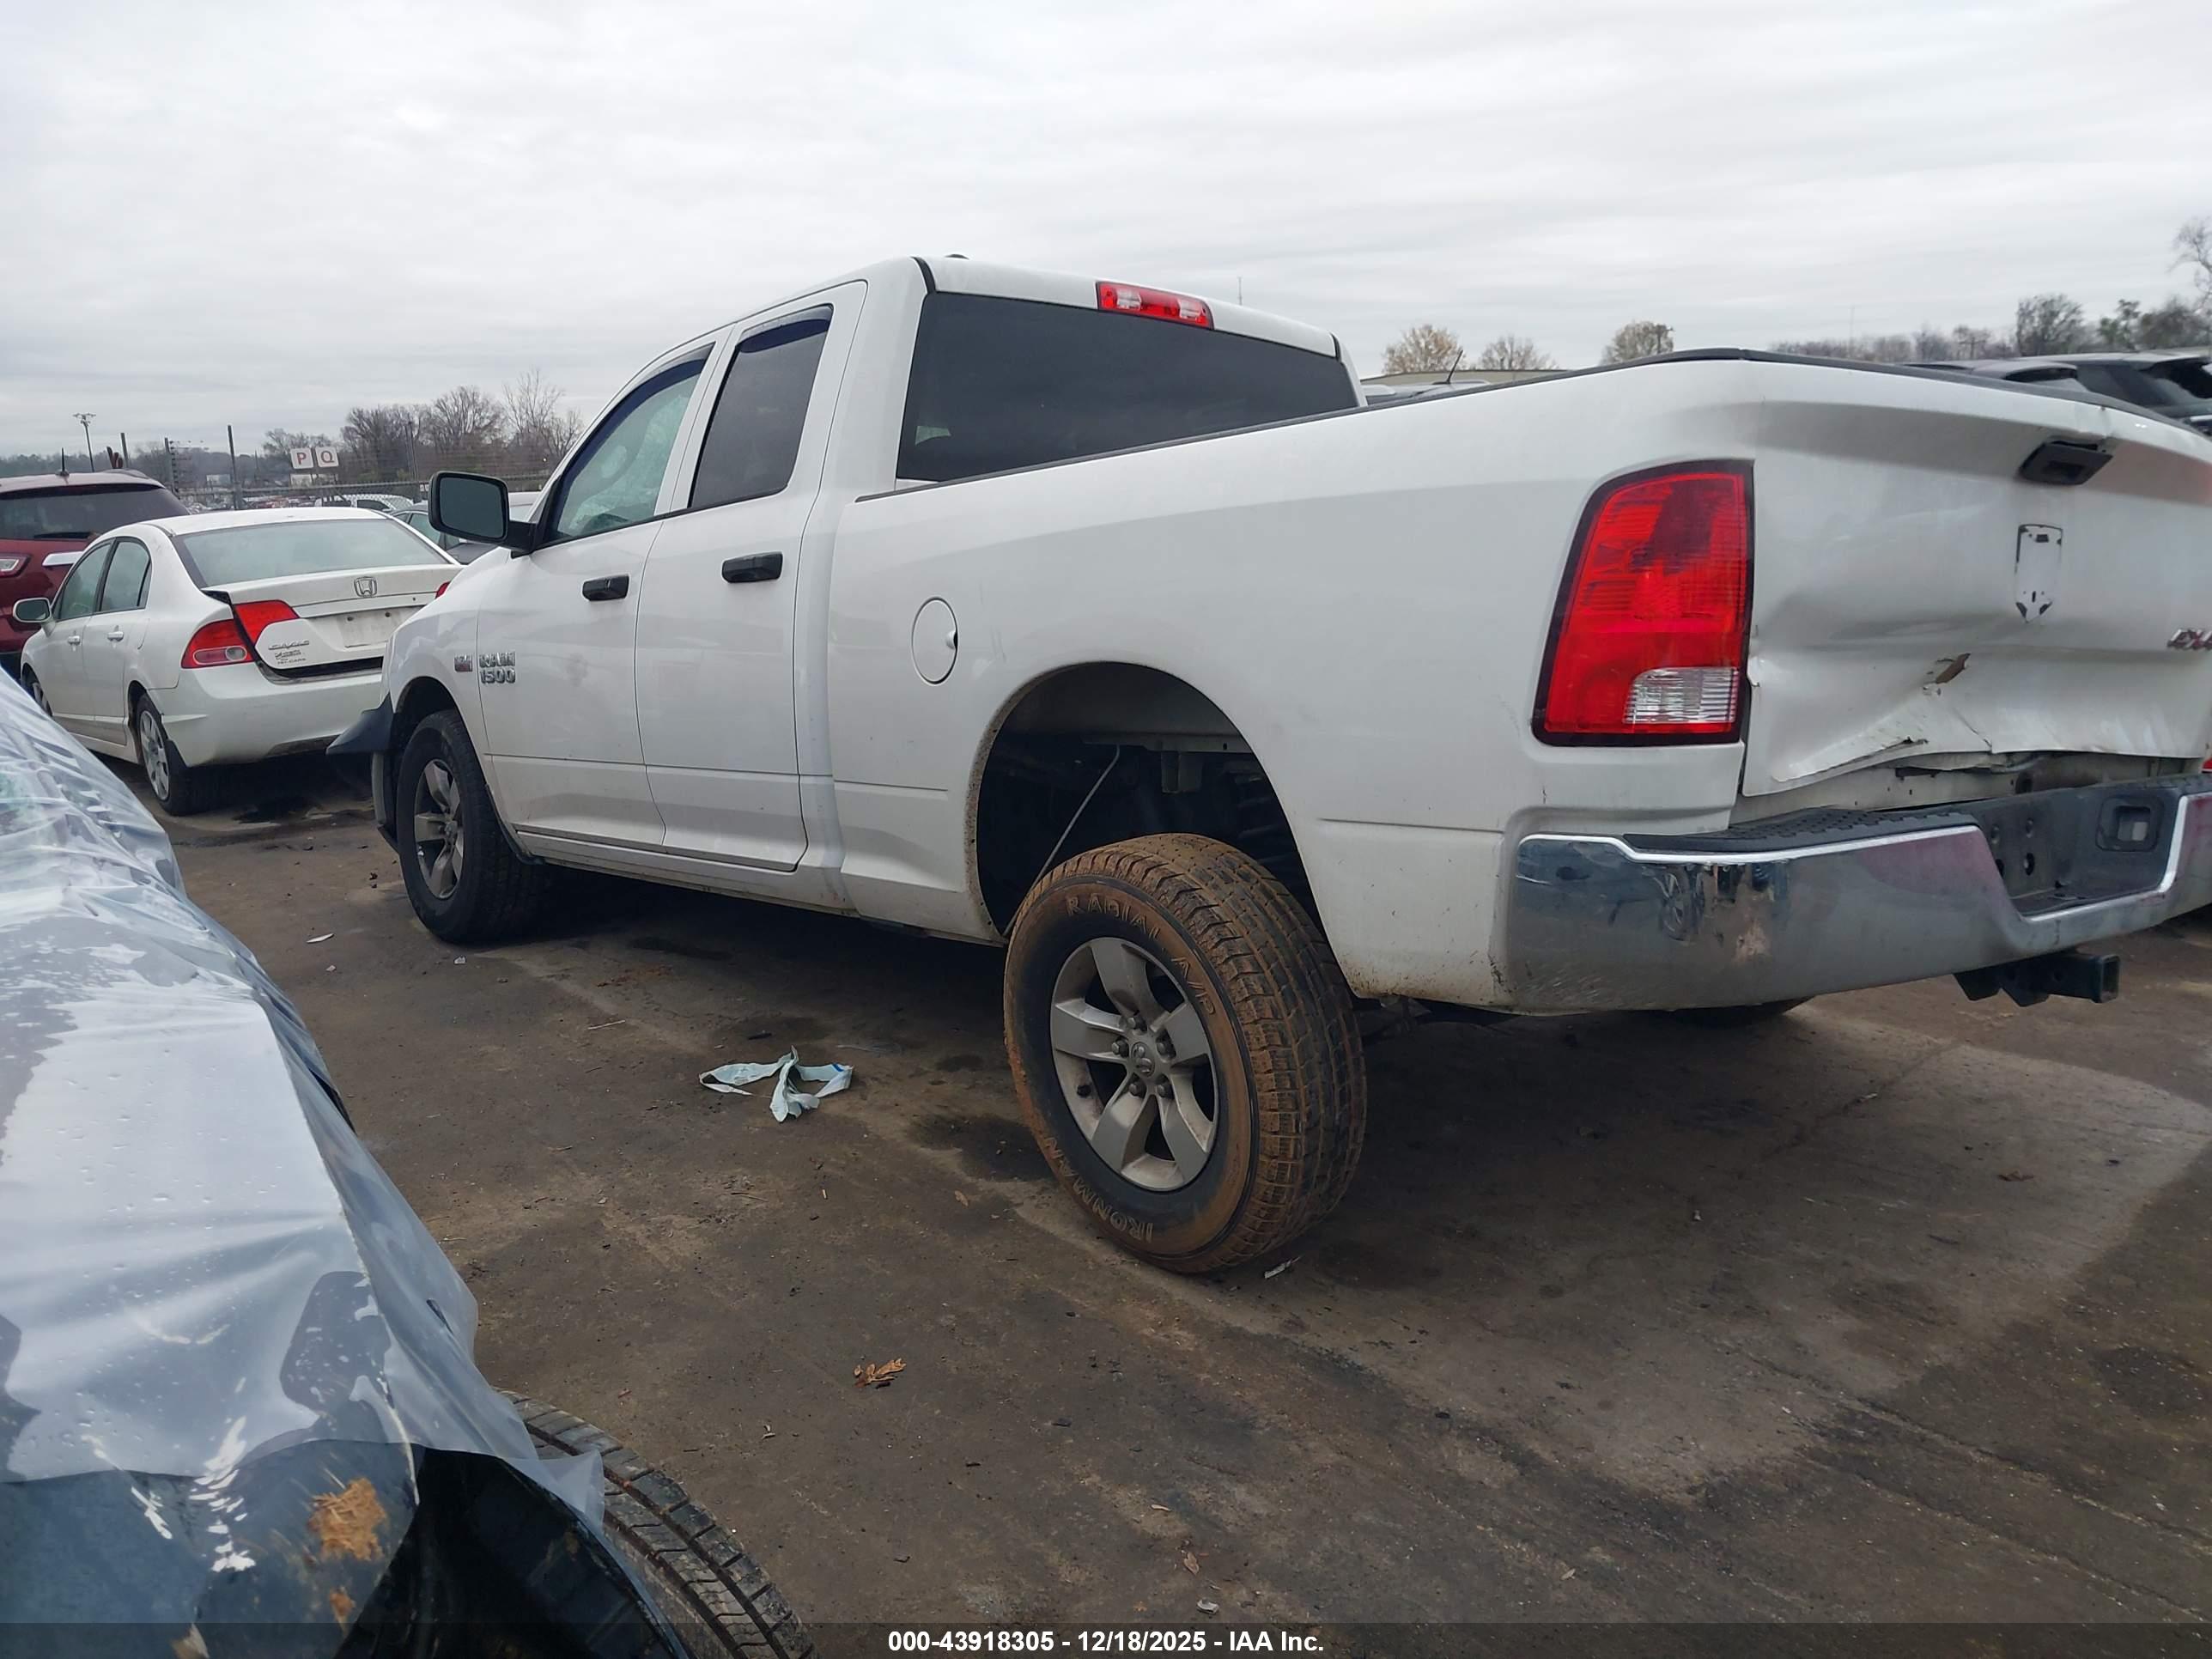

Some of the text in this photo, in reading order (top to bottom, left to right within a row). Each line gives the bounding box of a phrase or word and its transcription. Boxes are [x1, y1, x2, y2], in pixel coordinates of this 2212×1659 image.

[296, 452, 307, 465] P
[320, 450, 335, 464] Q
[478, 652, 515, 667] RAM
[480, 668, 516, 684] 1500
[1066, 892, 1159, 941] RADIAL
[1036, 1136, 1154, 1243] IRONMAN
